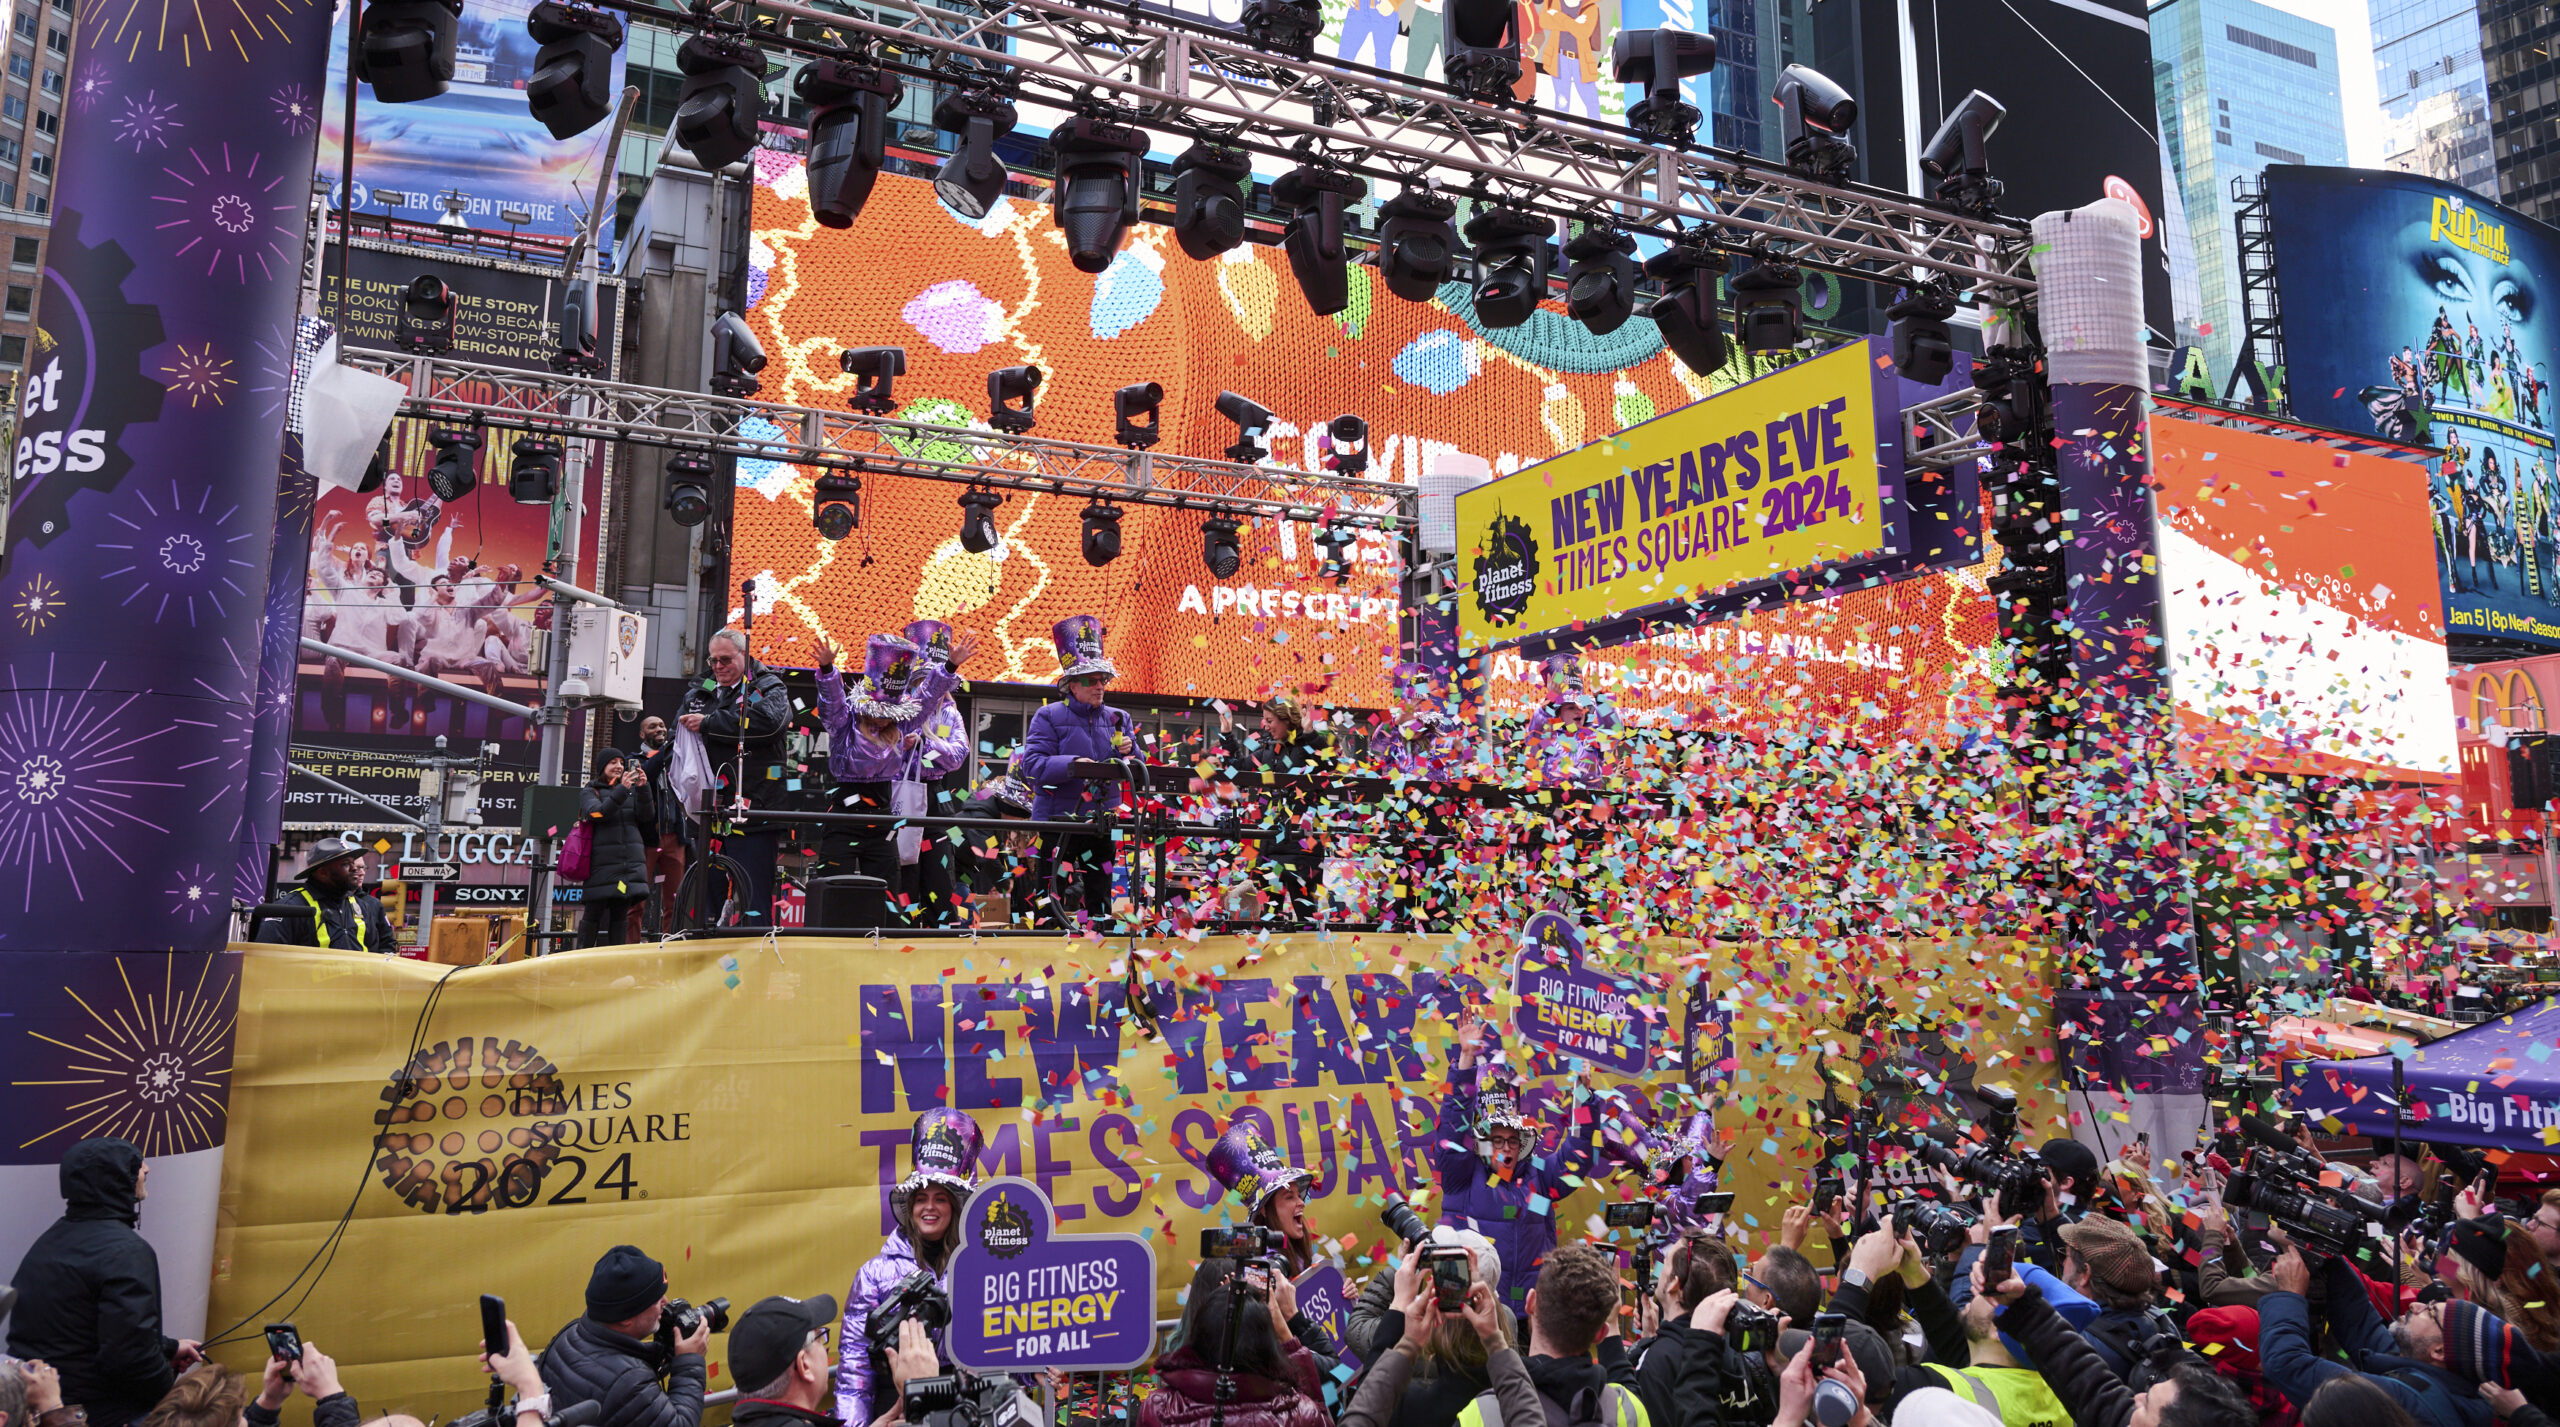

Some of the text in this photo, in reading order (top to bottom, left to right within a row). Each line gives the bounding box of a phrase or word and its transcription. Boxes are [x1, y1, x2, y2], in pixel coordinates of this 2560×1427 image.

[2471, 242, 2510, 266] DRAG RACE
[485, 298, 539, 315] STORY
[2457, 415, 2465, 424] TO
[2467, 417, 2478, 427] THE
[1551, 396, 1850, 550] NEW YEAR'S EVE
[1553, 467, 1852, 595] TIMES SQUARE 2024
[1479, 559, 1524, 593] planet
[1178, 585, 1208, 615] A
[1484, 578, 1533, 604] fitness
[2450, 606, 2473, 625] Jan
[2474, 609, 2485, 627] 5
[2491, 611, 2508, 633] 8p
[2508, 613, 2531, 633] New
[483, 770, 514, 783] PER
[495, 798, 516, 809] ST.
[408, 868, 451, 876] ONE WAY
[455, 888, 525, 901] SONY
[860, 982, 1126, 1114] NEW
[506, 1082, 632, 1117] TIMES
[2449, 1093, 2496, 1133] Big
[530, 1112, 691, 1153] SQUARE
[921, 1142, 955, 1154] planet
[923, 1149, 958, 1164] fitness
[450, 1152, 639, 1214] 2024
[984, 1226, 1021, 1239] planet
[989, 1236, 1028, 1246] fitness
[984, 1258, 1118, 1305] BIG FITNESS
[983, 1290, 1120, 1338] ENERGY
[1016, 1329, 1091, 1358] FOR ALL
